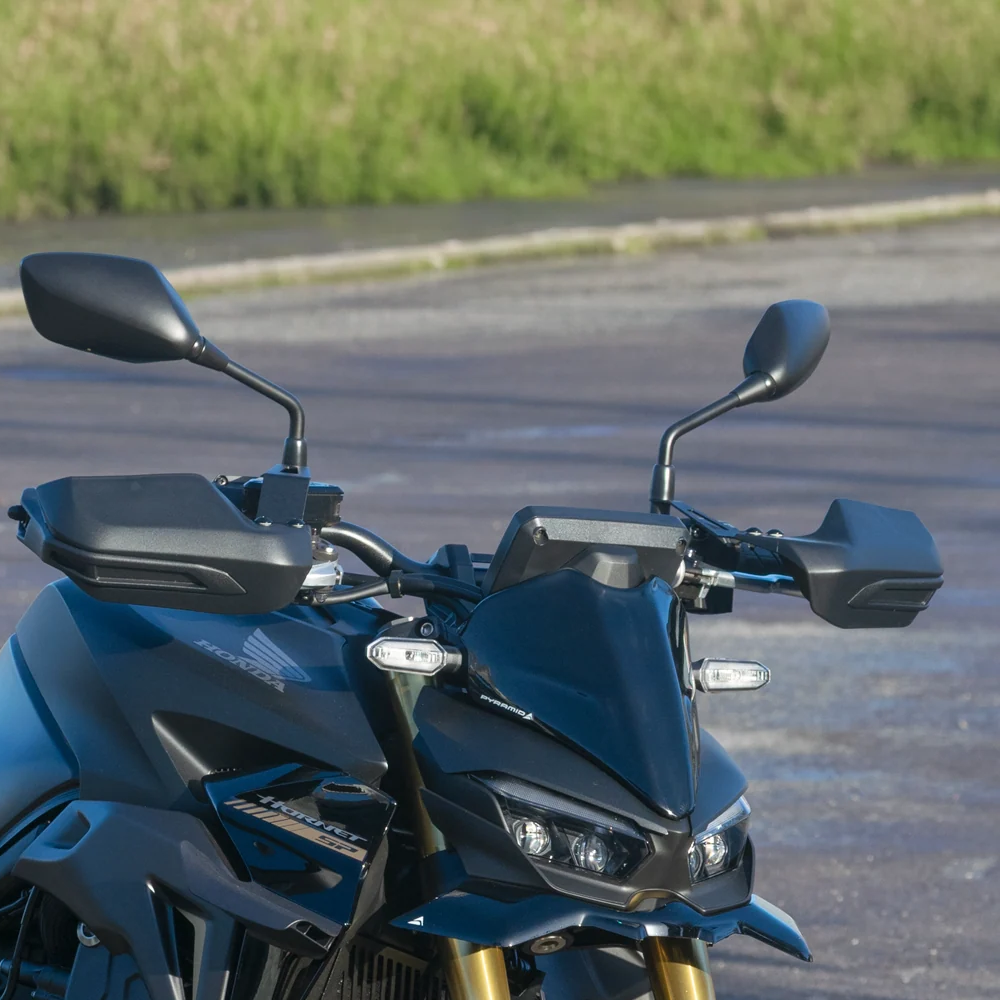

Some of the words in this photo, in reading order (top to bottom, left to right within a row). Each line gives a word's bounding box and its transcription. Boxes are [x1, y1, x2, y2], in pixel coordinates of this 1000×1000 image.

[193, 639, 285, 693] HONDA
[480, 694, 526, 717] PYRAMID
[256, 794, 368, 842] HORNET
[315, 835, 359, 854] SP
